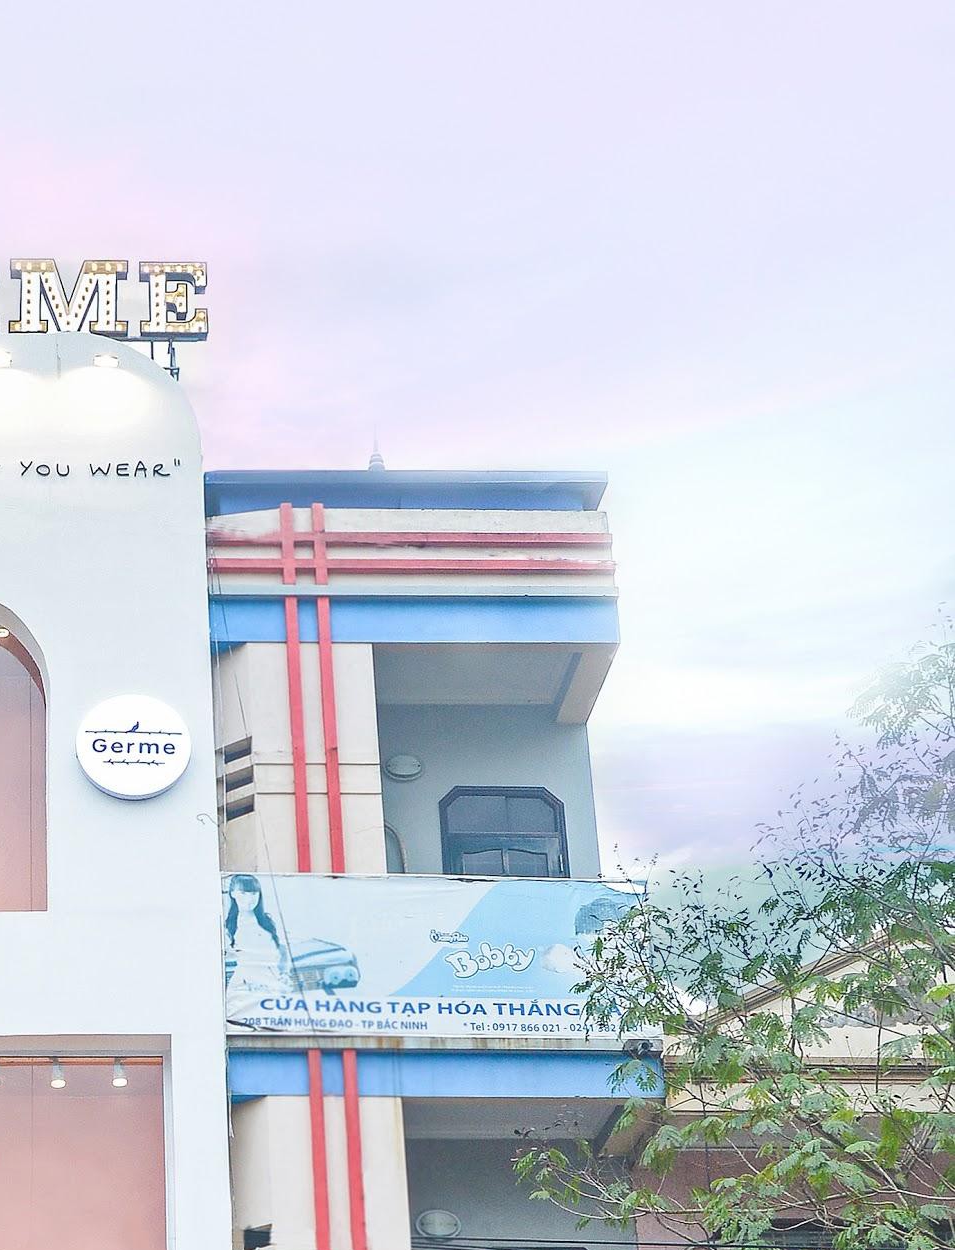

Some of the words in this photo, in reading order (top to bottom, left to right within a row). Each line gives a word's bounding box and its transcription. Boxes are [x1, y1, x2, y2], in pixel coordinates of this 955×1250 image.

[20, 461, 70, 478] YOU
[92, 739, 175, 755] Germe
[445, 942, 536, 978] Bobby
[260, 997, 308, 1012] CỬA
[315, 997, 382, 1014] HÀNG
[388, 1001, 431, 1017] TẠP
[438, 1000, 487, 1016] HÓA
[493, 998, 580, 1017] THẮNG
[361, 1020, 374, 1029] TP
[401, 1020, 428, 1030] NINH
[492, 1022, 517, 1032] 0917
[520, 1023, 540, 1032] 866
[542, 1023, 561, 1033] 021
